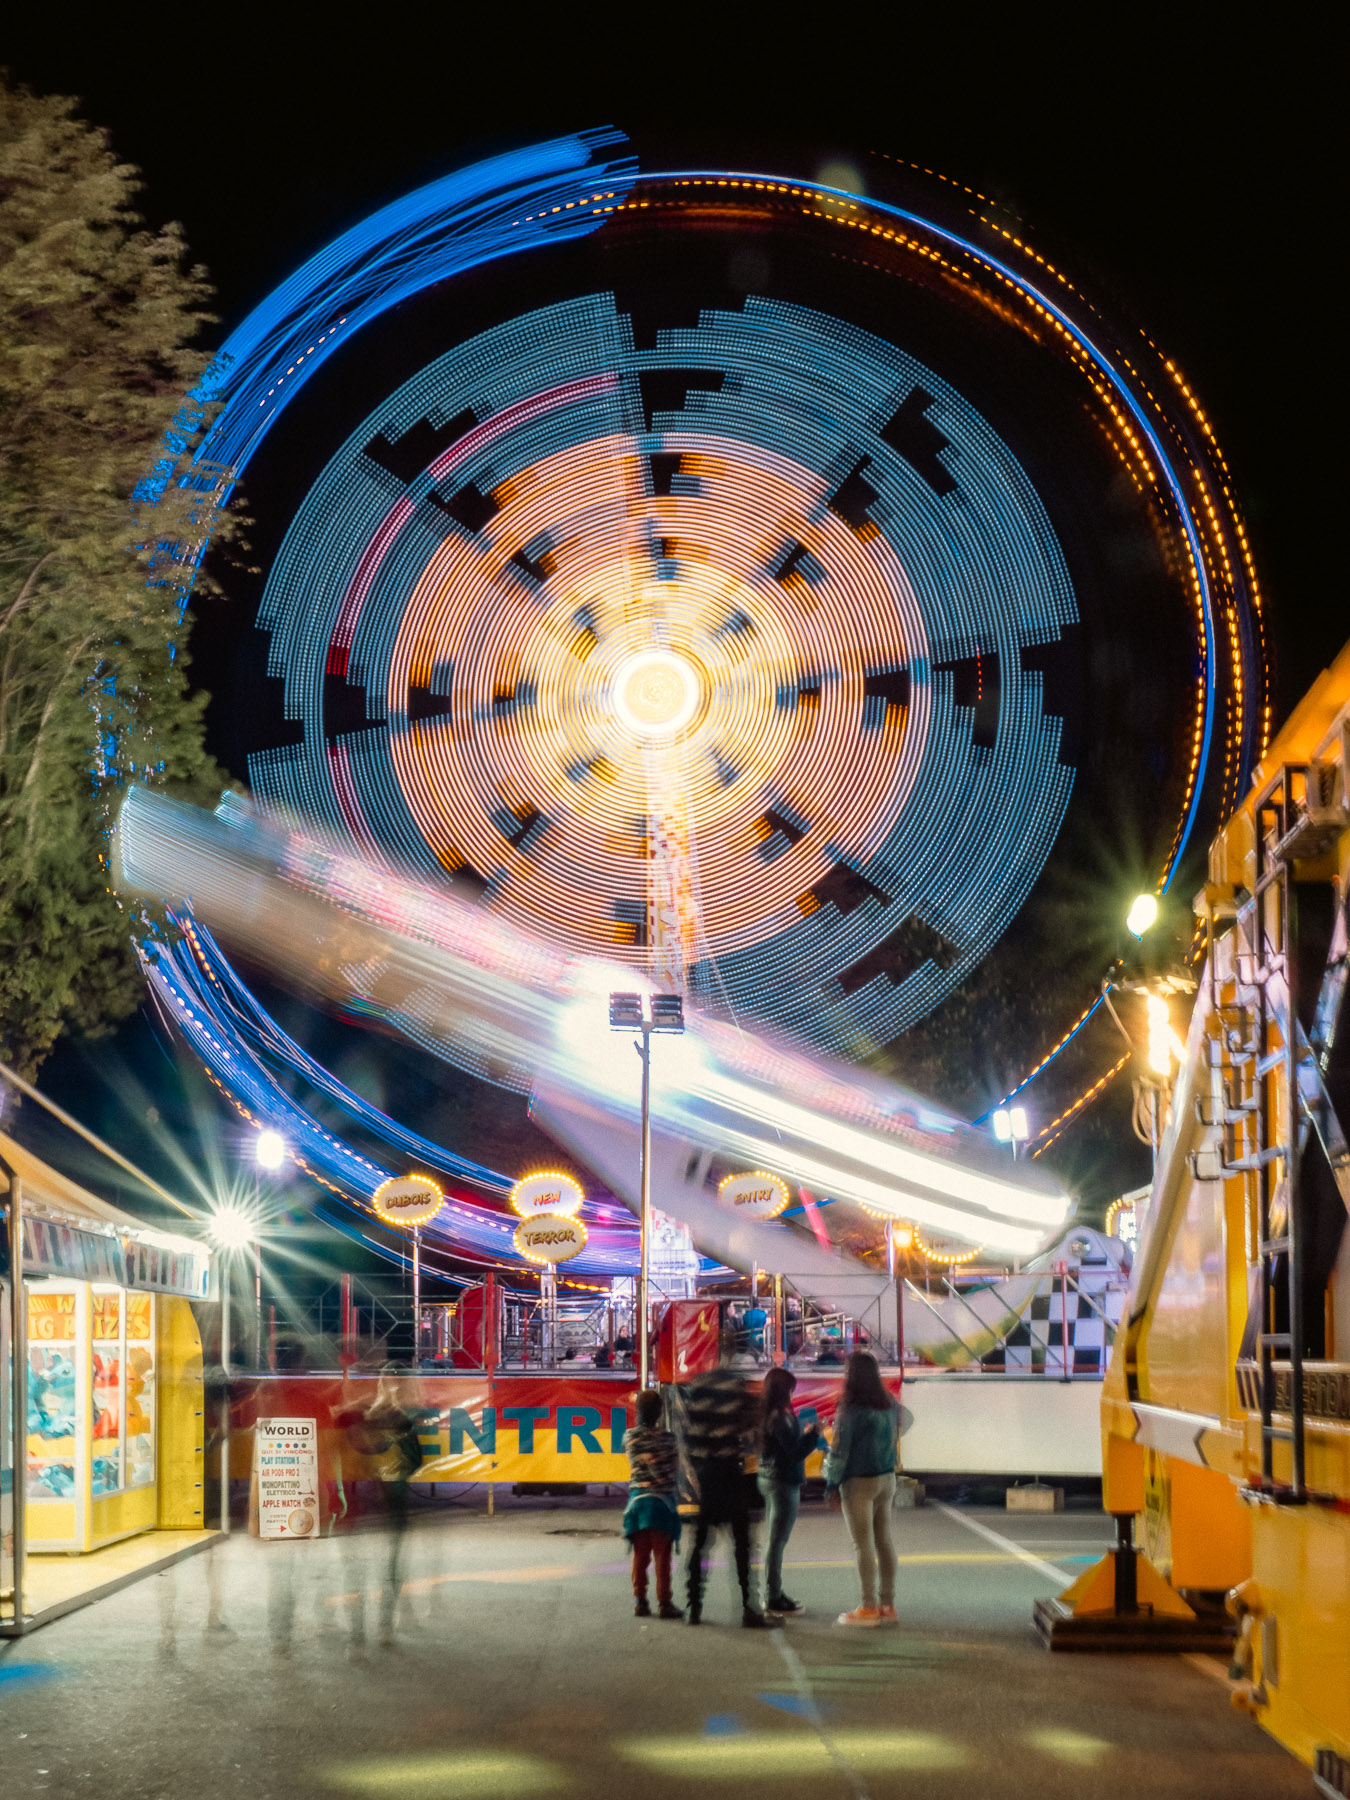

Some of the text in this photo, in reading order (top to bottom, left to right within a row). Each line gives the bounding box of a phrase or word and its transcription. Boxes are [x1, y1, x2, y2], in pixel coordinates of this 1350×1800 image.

[386, 1191, 431, 1209] DUBOIS
[533, 1190, 561, 1206] NEW
[734, 1187, 773, 1206] ENTRY
[524, 1230, 576, 1246] TERROR
[56, 1295, 105, 1314] WN
[28, 1314, 151, 1340] IG PIZES
[264, 1426, 310, 1436] WORLD
[261, 1456, 274, 1465] PLAY
[275, 1456, 296, 1465] STATION
[261, 1467, 300, 1477] AIR PODS PRO 2
[261, 1480, 301, 1489] MONOPATTINO
[262, 1499, 302, 1508] APPLE WATCH
